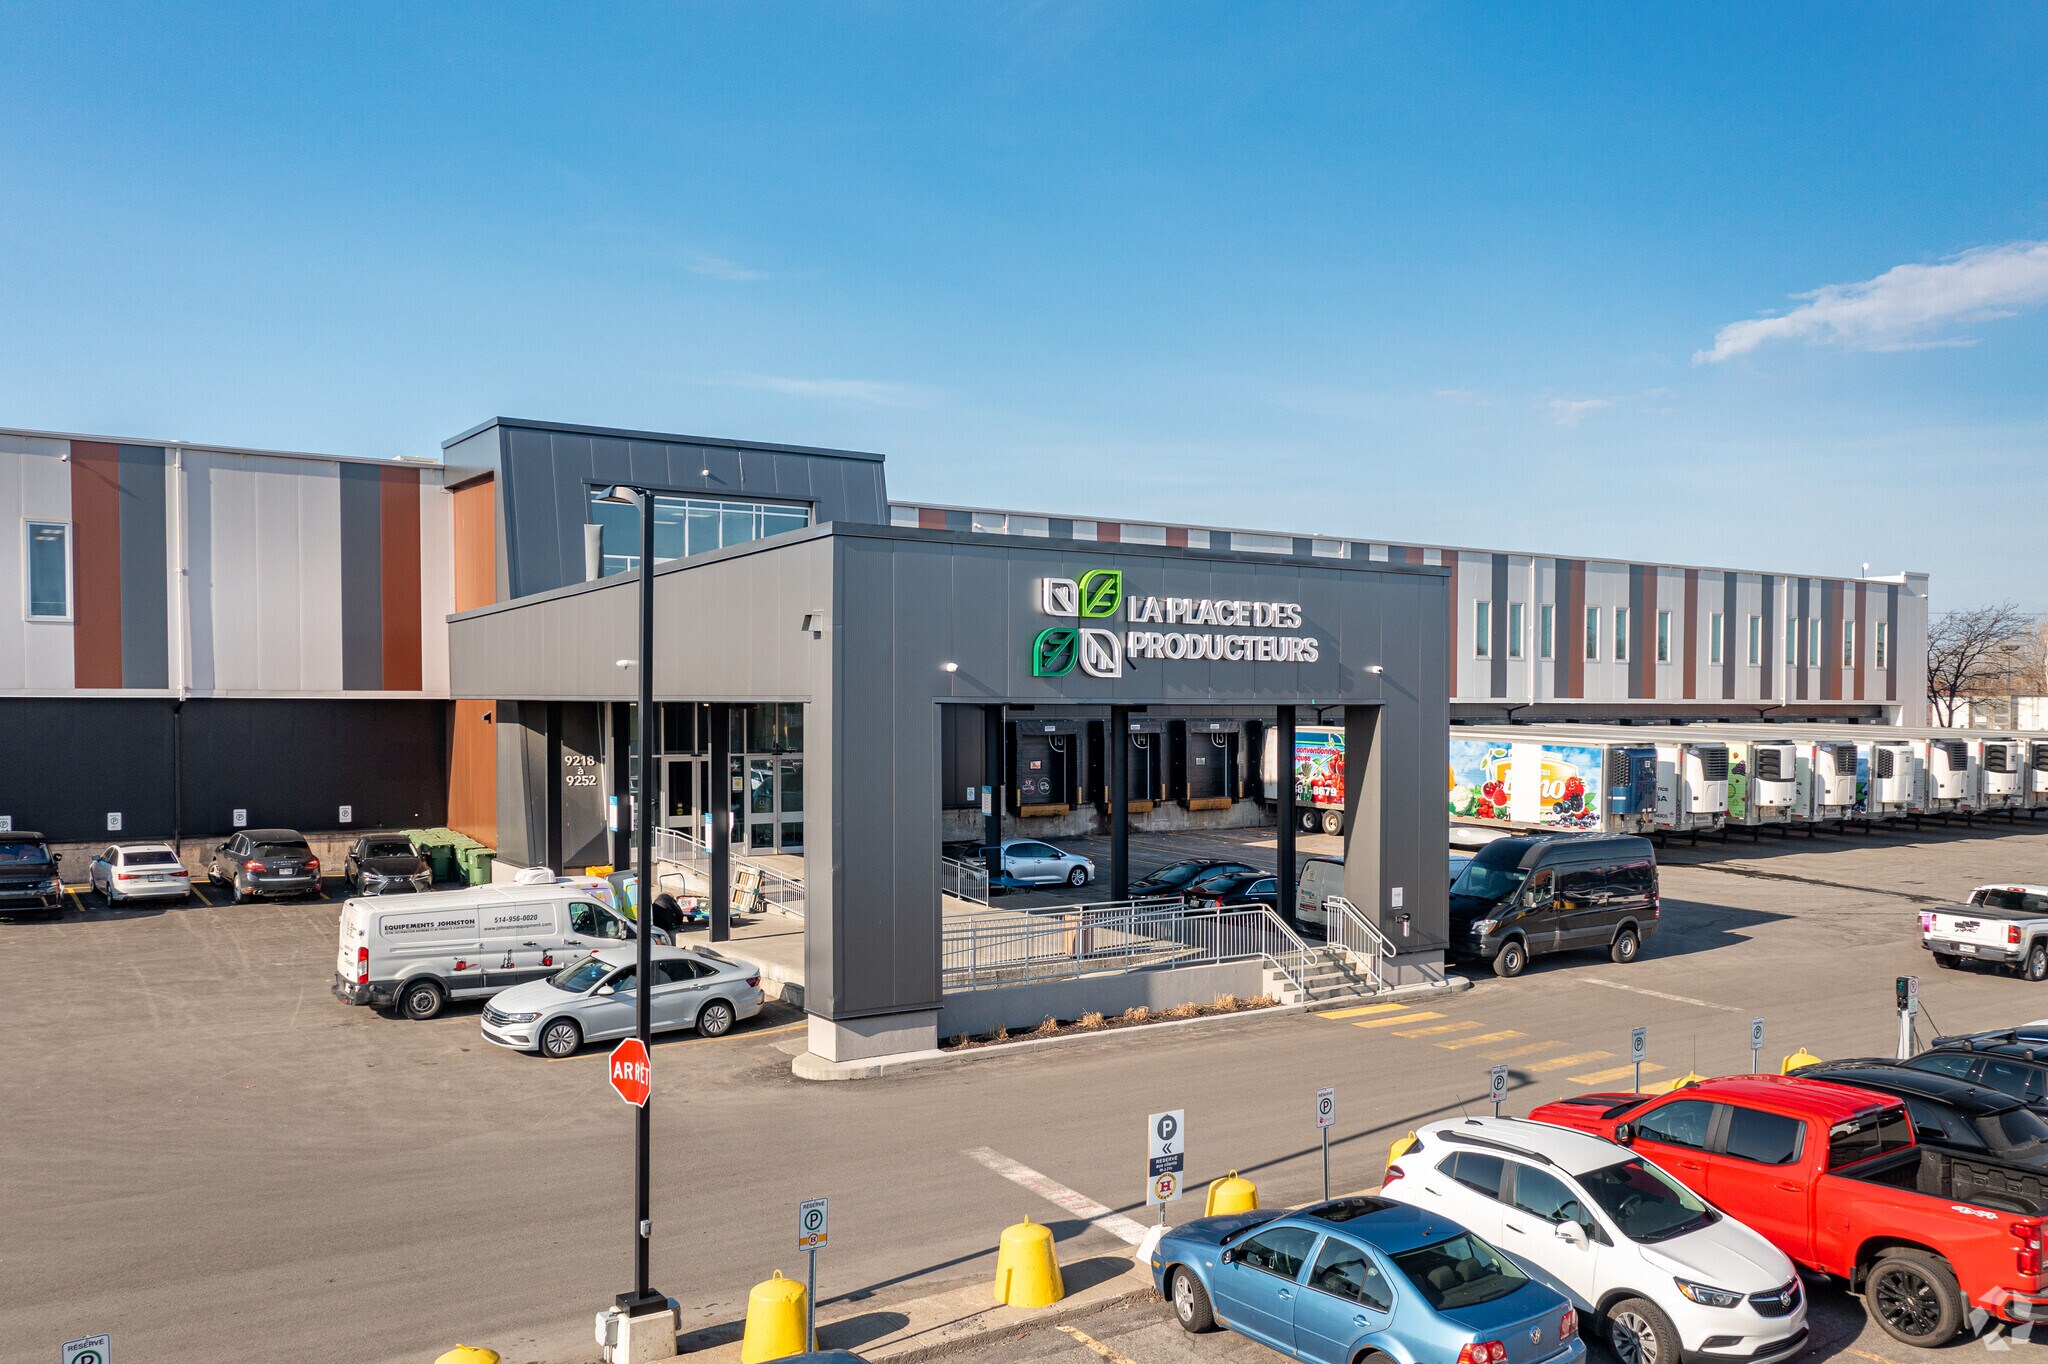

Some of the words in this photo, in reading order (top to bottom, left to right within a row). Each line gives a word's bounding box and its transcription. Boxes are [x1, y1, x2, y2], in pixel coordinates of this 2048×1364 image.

[1127, 595, 1164, 623] LA
[1166, 597, 1251, 627] PLACE
[1252, 601, 1302, 629] DES
[1127, 631, 1319, 663] PRODUCTEURS
[564, 755, 596, 767] 9218
[577, 766, 585, 775] à
[565, 775, 598, 787] 9252
[384, 922, 435, 931] EQUIPEMENTS
[437, 919, 475, 927] JOHNSTON
[613, 1061, 650, 1086] ARRÊT
